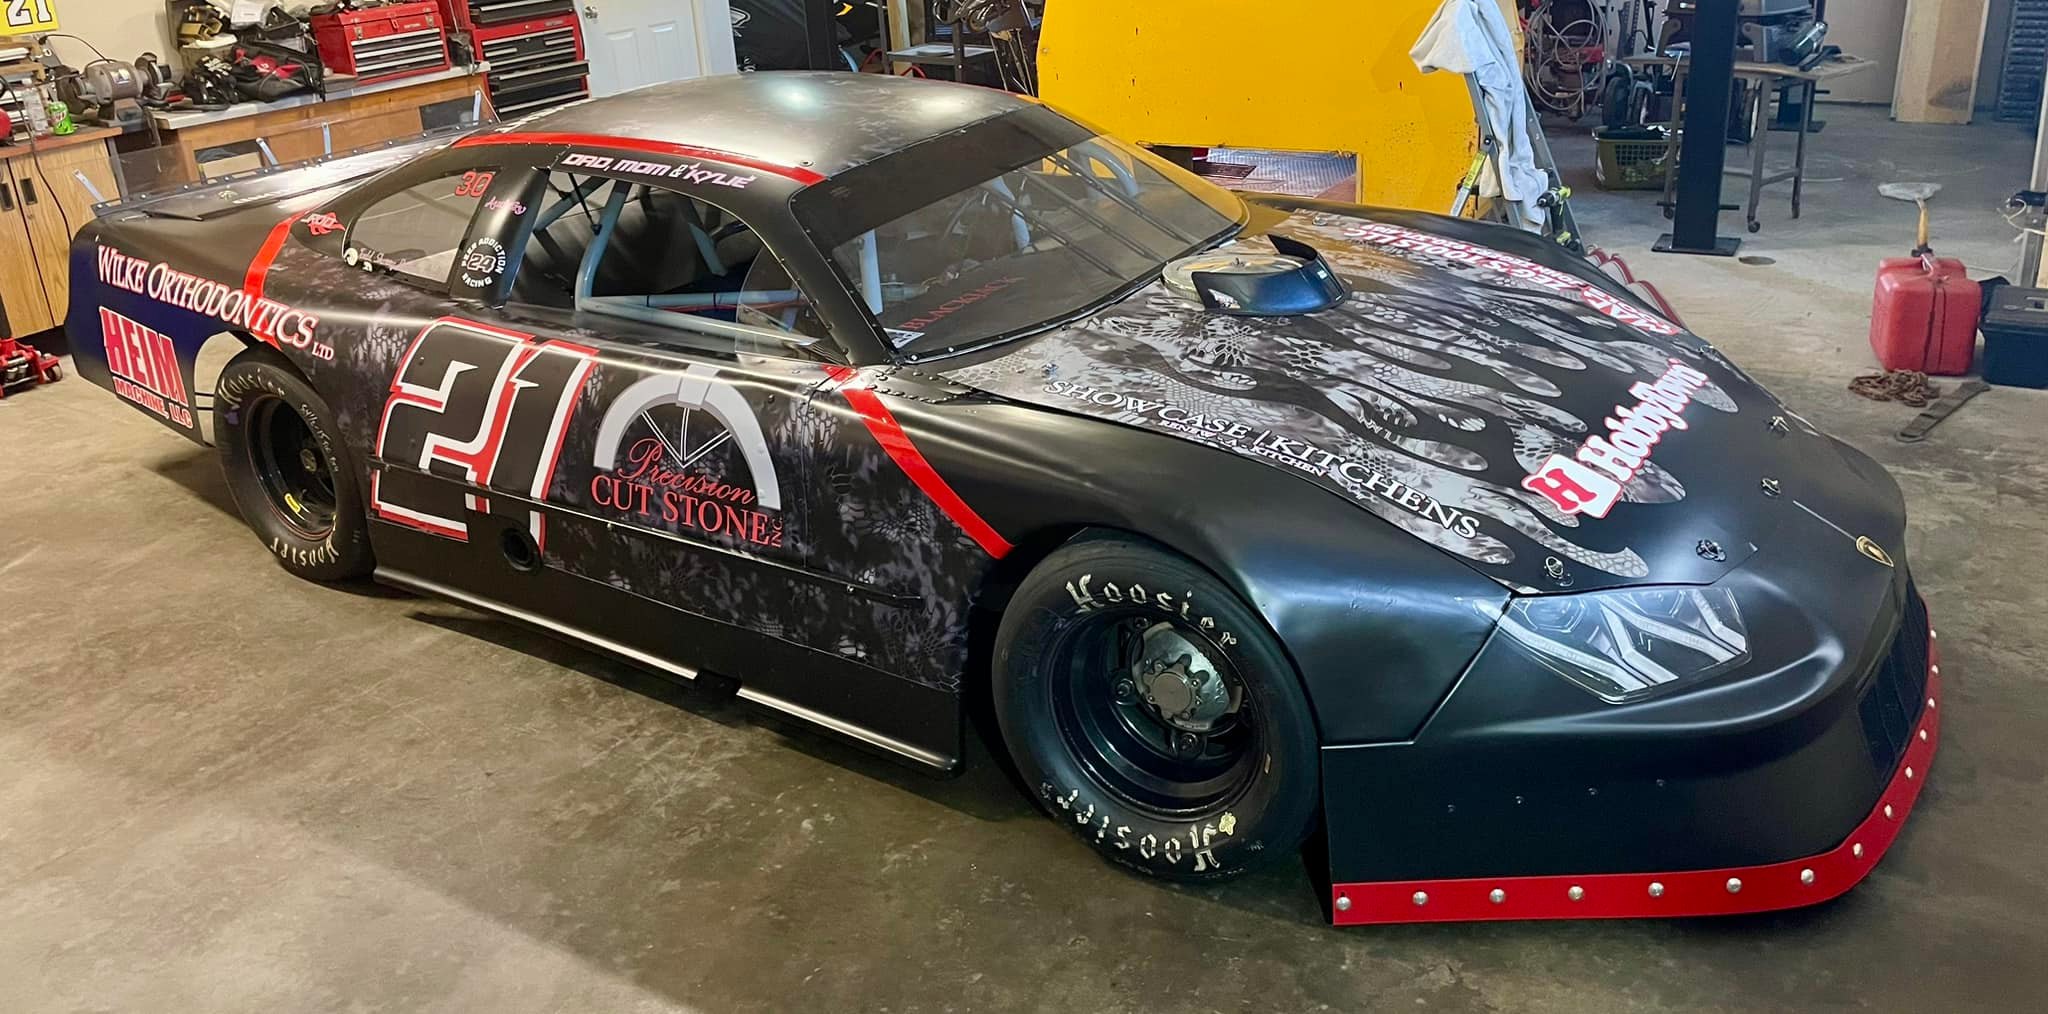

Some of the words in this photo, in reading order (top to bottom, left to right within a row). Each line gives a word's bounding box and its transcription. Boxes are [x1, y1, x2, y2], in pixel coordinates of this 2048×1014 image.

[455, 171, 494, 197] 30
[613, 159, 672, 177] MOM
[479, 237, 506, 274] ADDICTION
[1343, 227, 1400, 245] LLC
[1389, 237, 1497, 265] TOOLS
[461, 272, 493, 288] RACING
[466, 252, 497, 274] 24
[98, 245, 149, 294] WILKE
[148, 262, 319, 350] ORTHODONTICS
[311, 341, 335, 361] LTD
[99, 306, 189, 408] HEIM
[168, 402, 194, 429] LLC
[370, 315, 600, 556] 21
[1575, 362, 1709, 483] HobbyTown
[617, 437, 756, 504] Precision
[1046, 380, 1252, 440] SHOWCASE
[1265, 433, 1481, 541] KITCHENS
[1250, 445, 1328, 478] KITCHEN
[591, 475, 654, 516] CUT
[662, 491, 770, 546] STONE
[1064, 573, 1238, 649] Hoosier
[1056, 787, 1222, 873] Hoosier
